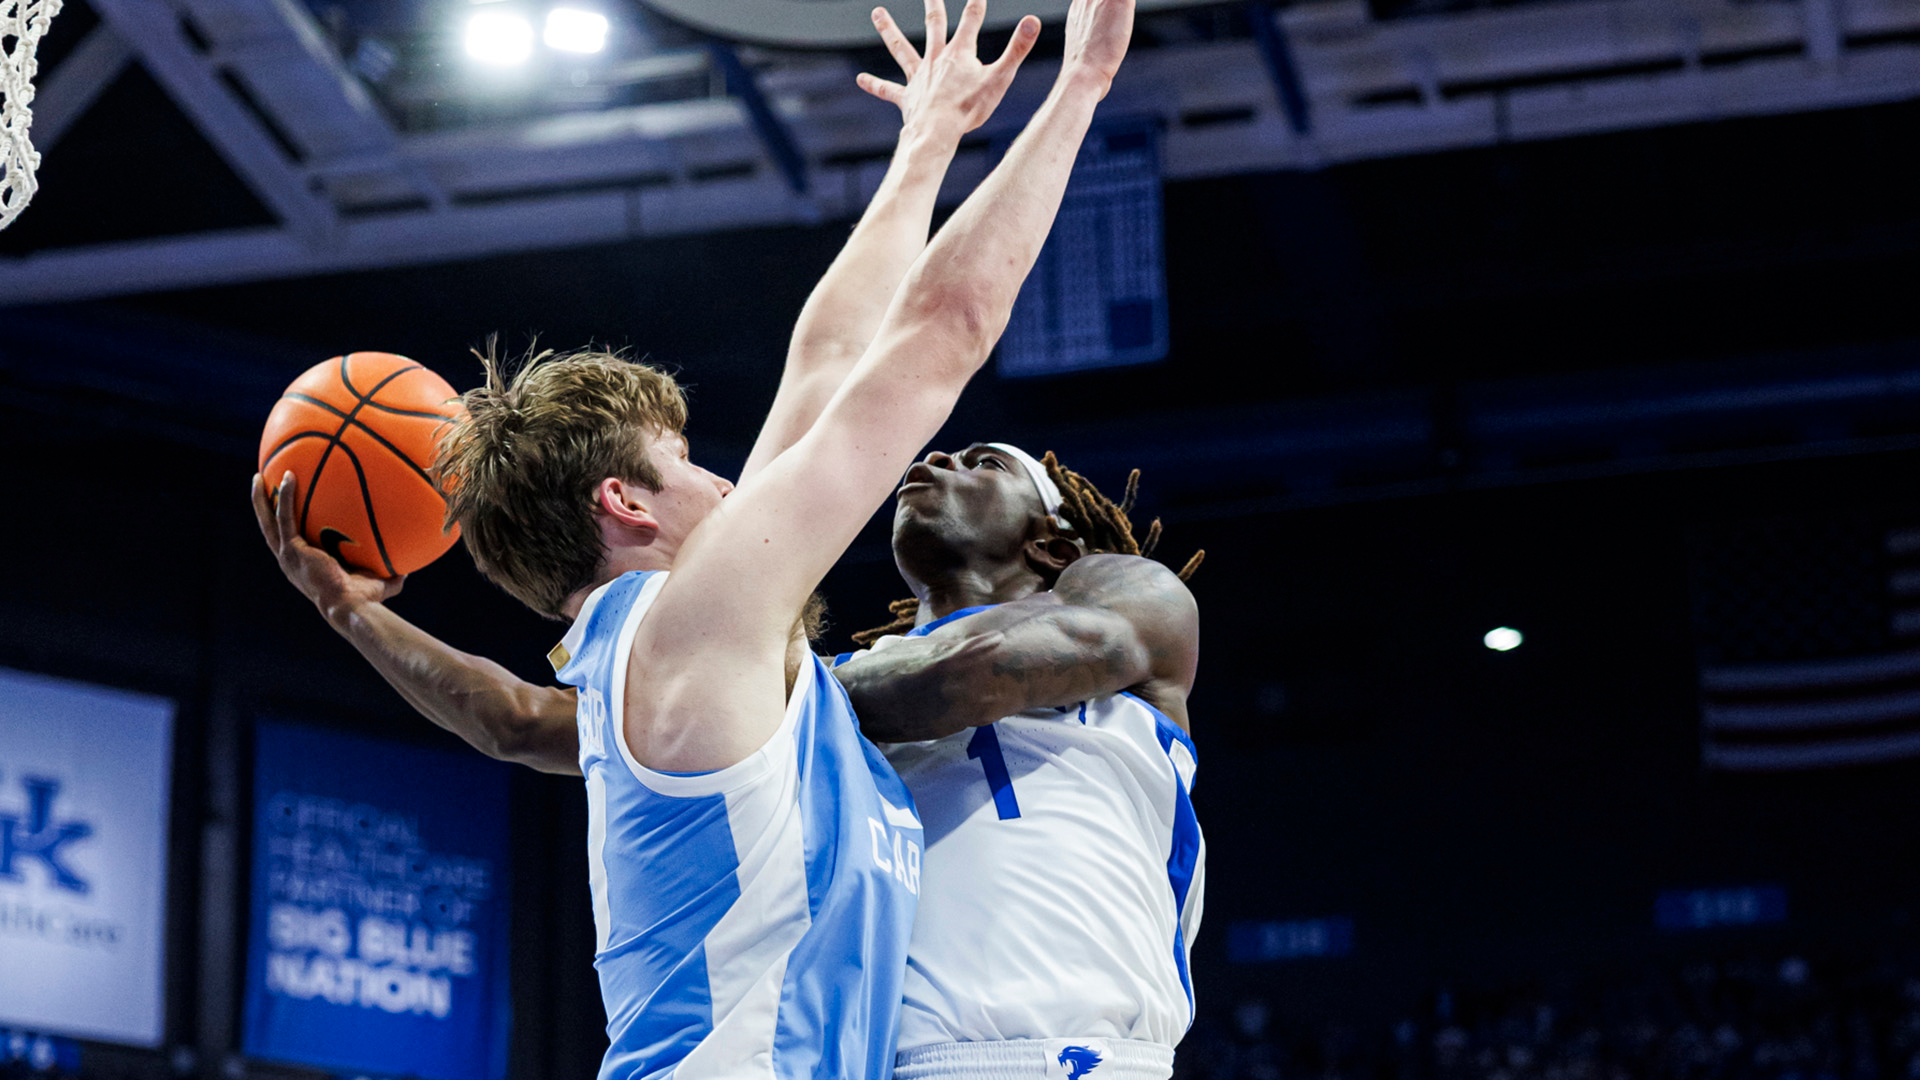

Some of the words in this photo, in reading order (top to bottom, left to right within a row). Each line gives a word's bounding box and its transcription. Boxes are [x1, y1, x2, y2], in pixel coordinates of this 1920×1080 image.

[966, 723, 1022, 821] 1
[267, 899, 351, 957] BIG
[357, 914, 477, 976] BLUE
[265, 950, 452, 1019] NATION
